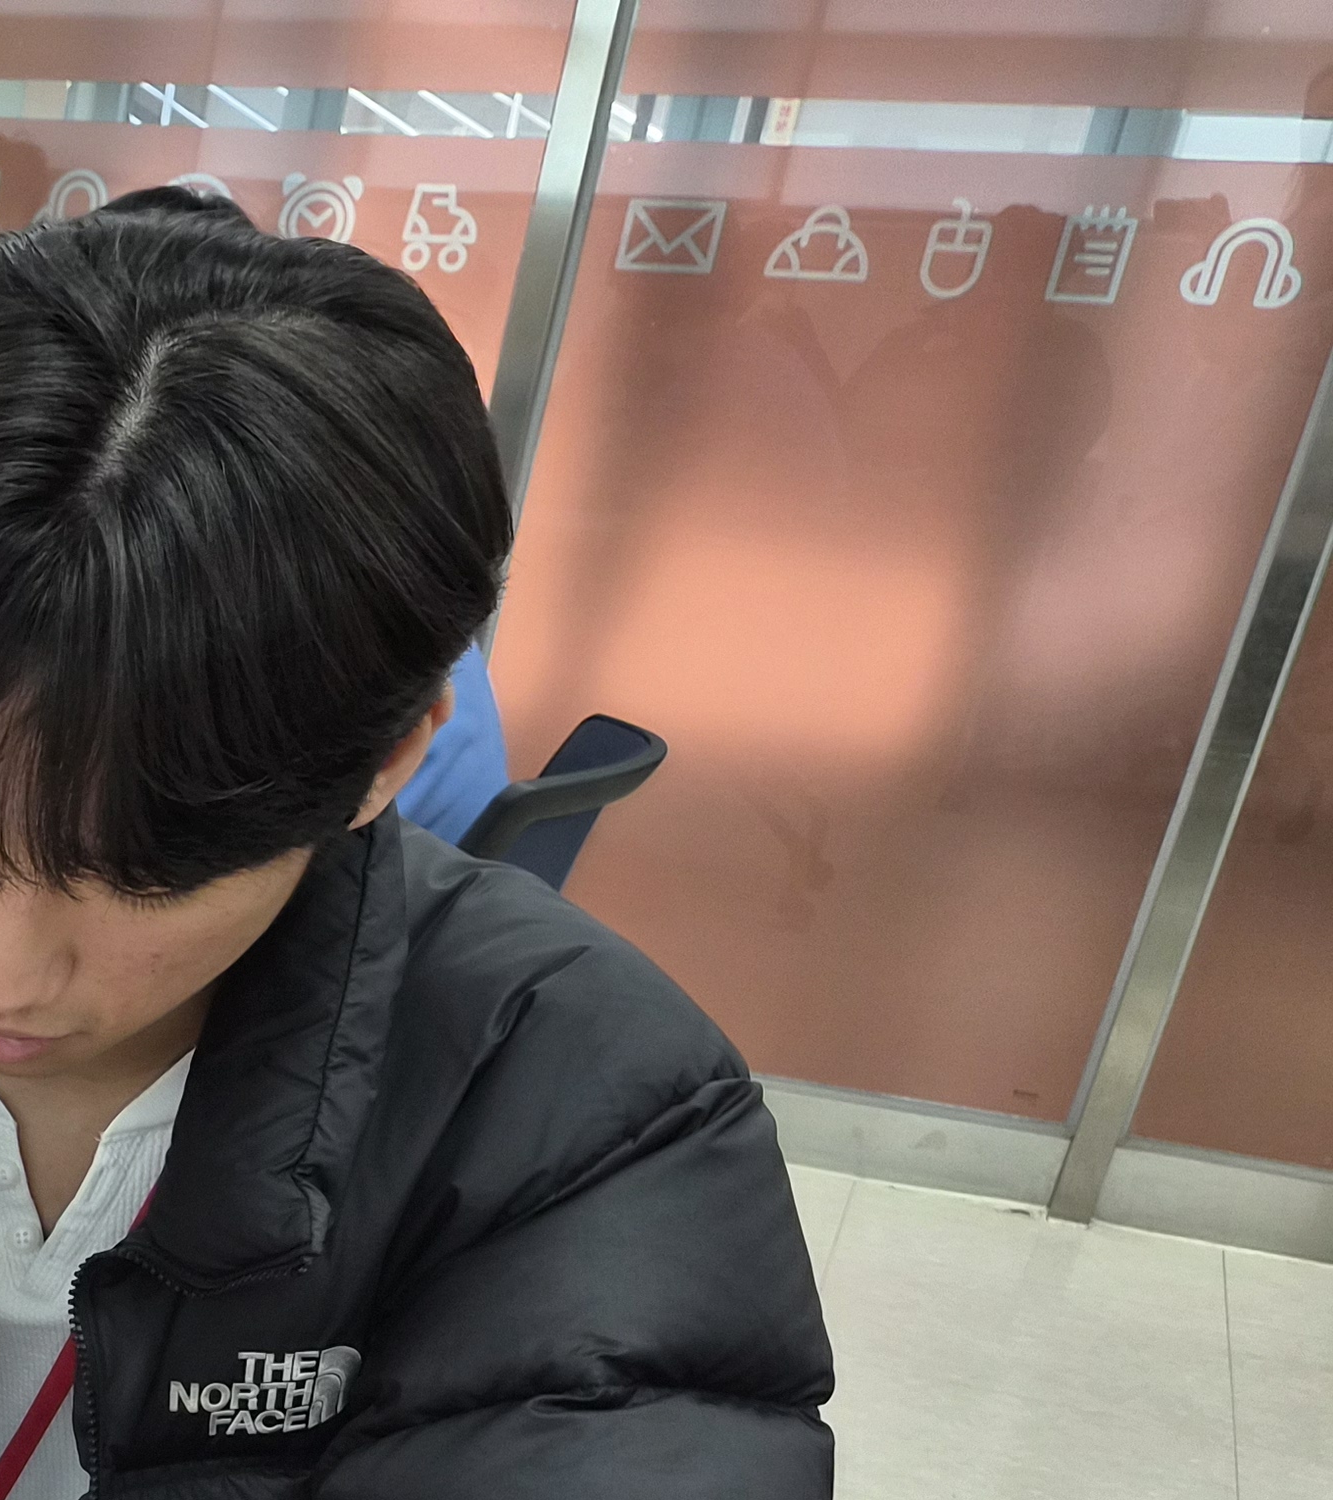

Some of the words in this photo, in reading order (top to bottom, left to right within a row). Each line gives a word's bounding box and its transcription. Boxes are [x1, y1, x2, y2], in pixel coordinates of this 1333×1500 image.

[238, 1350, 319, 1383] THE
[169, 1379, 314, 1413] NORTH
[209, 1405, 309, 1436] FACE
